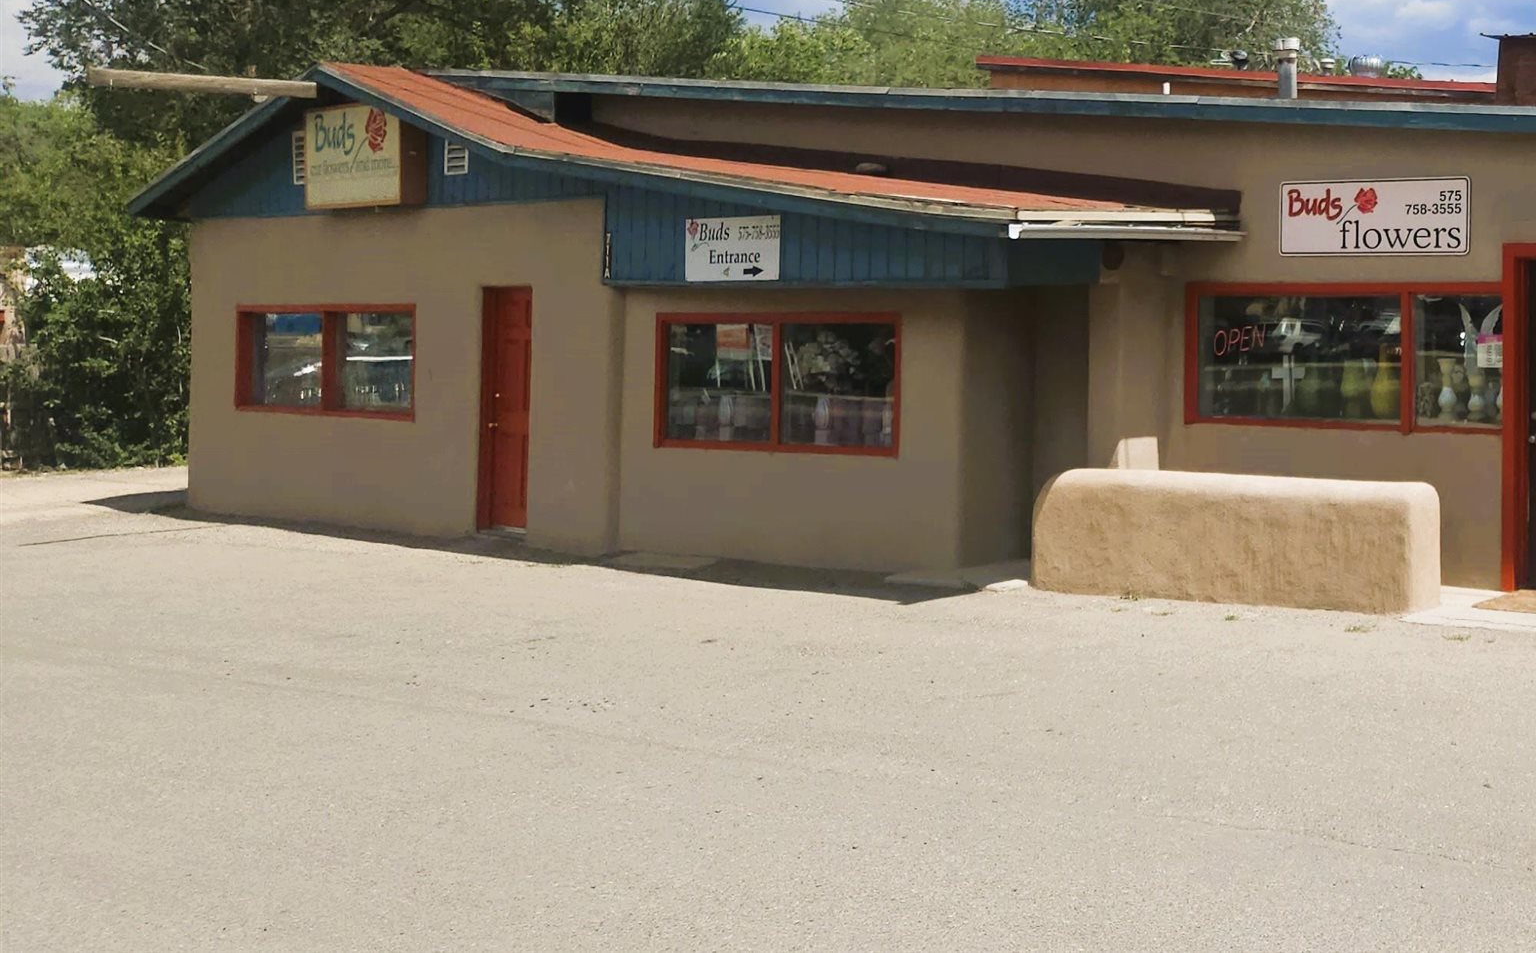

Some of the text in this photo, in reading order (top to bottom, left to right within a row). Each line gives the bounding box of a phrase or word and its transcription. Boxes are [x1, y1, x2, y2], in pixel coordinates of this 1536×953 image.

[315, 111, 355, 156] Buds
[1287, 188, 1343, 221] Buds
[1439, 190, 1462, 202] 575
[1405, 203, 1462, 215] 758-3555
[699, 222, 730, 242] Buds
[1339, 220, 1462, 249] flowers
[709, 249, 760, 265] Entrance
[1213, 323, 1267, 356] OPEN
